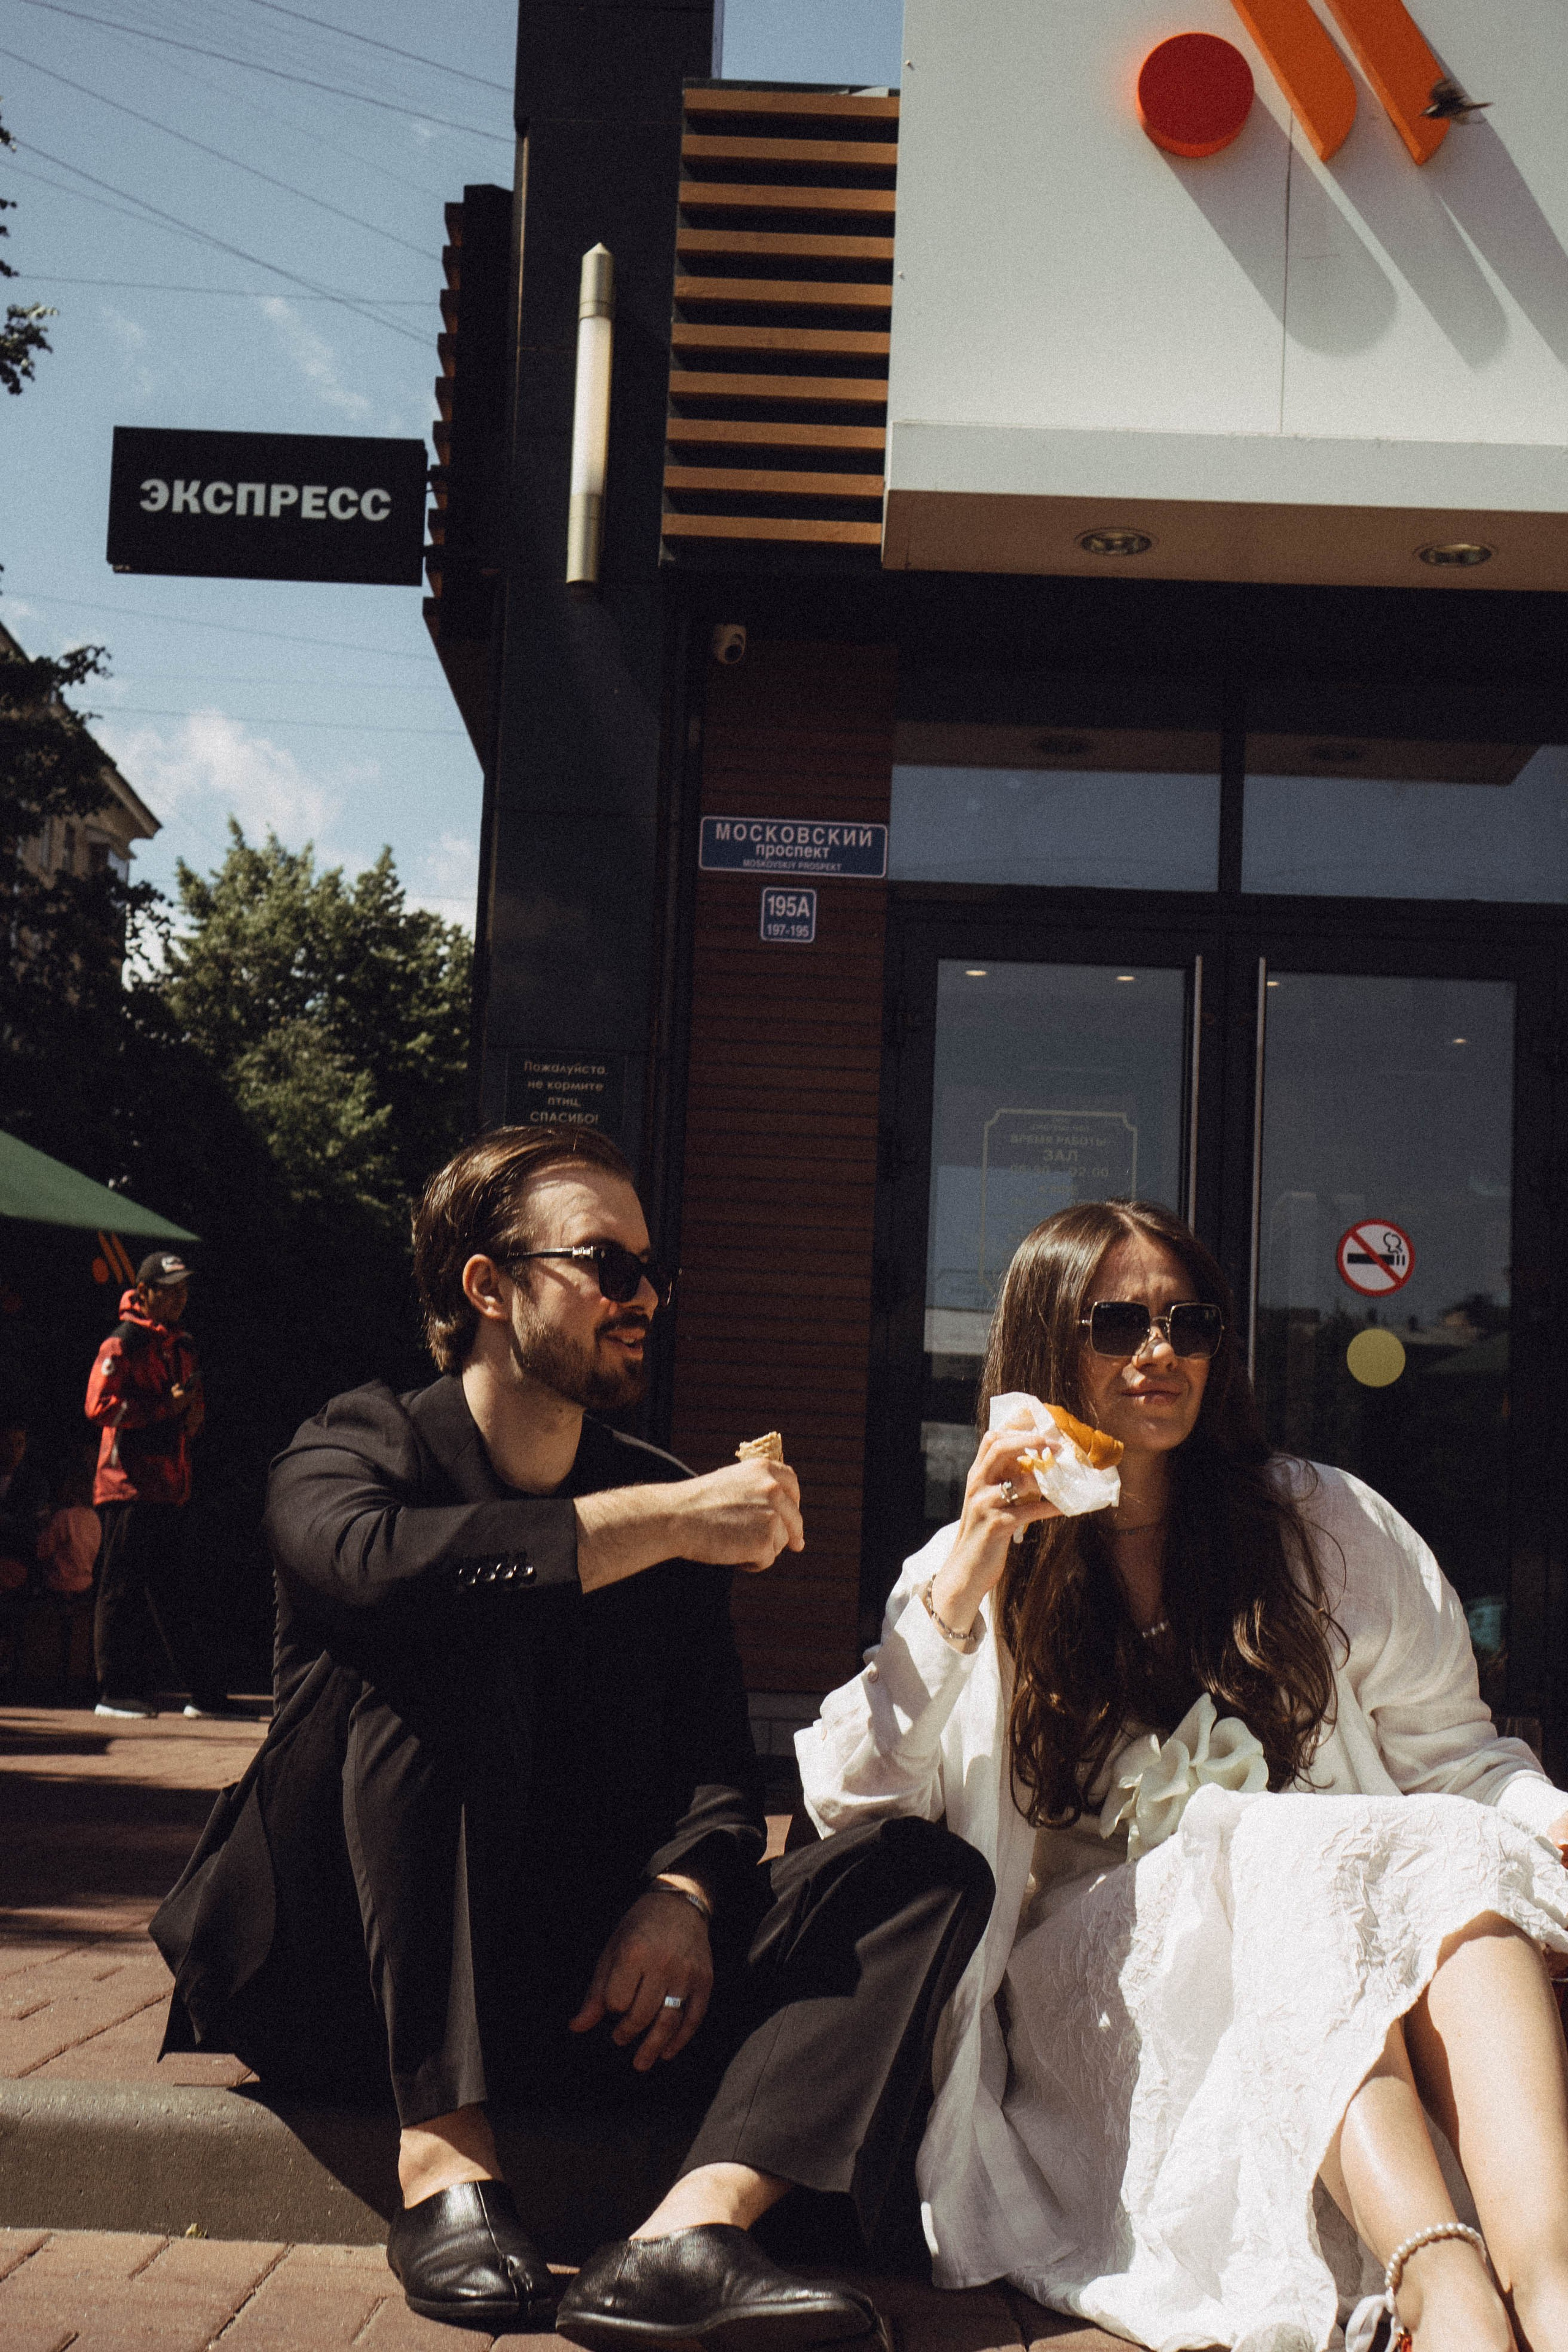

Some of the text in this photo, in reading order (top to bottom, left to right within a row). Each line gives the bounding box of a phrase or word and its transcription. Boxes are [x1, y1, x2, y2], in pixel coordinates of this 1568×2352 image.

[140, 478, 391, 521] ЭКСПРЕСС
[715, 823, 873, 847] МОСКОВСКИЙ
[756, 844, 830, 859] проспект
[798, 862, 842, 872] PROSPEKT
[767, 924, 809, 938] 197-195
[528, 1080, 603, 1092] не кормите
[530, 1110, 598, 1124] СПАСИБО!
[1042, 1149, 1079, 1162] ЗАЛ
